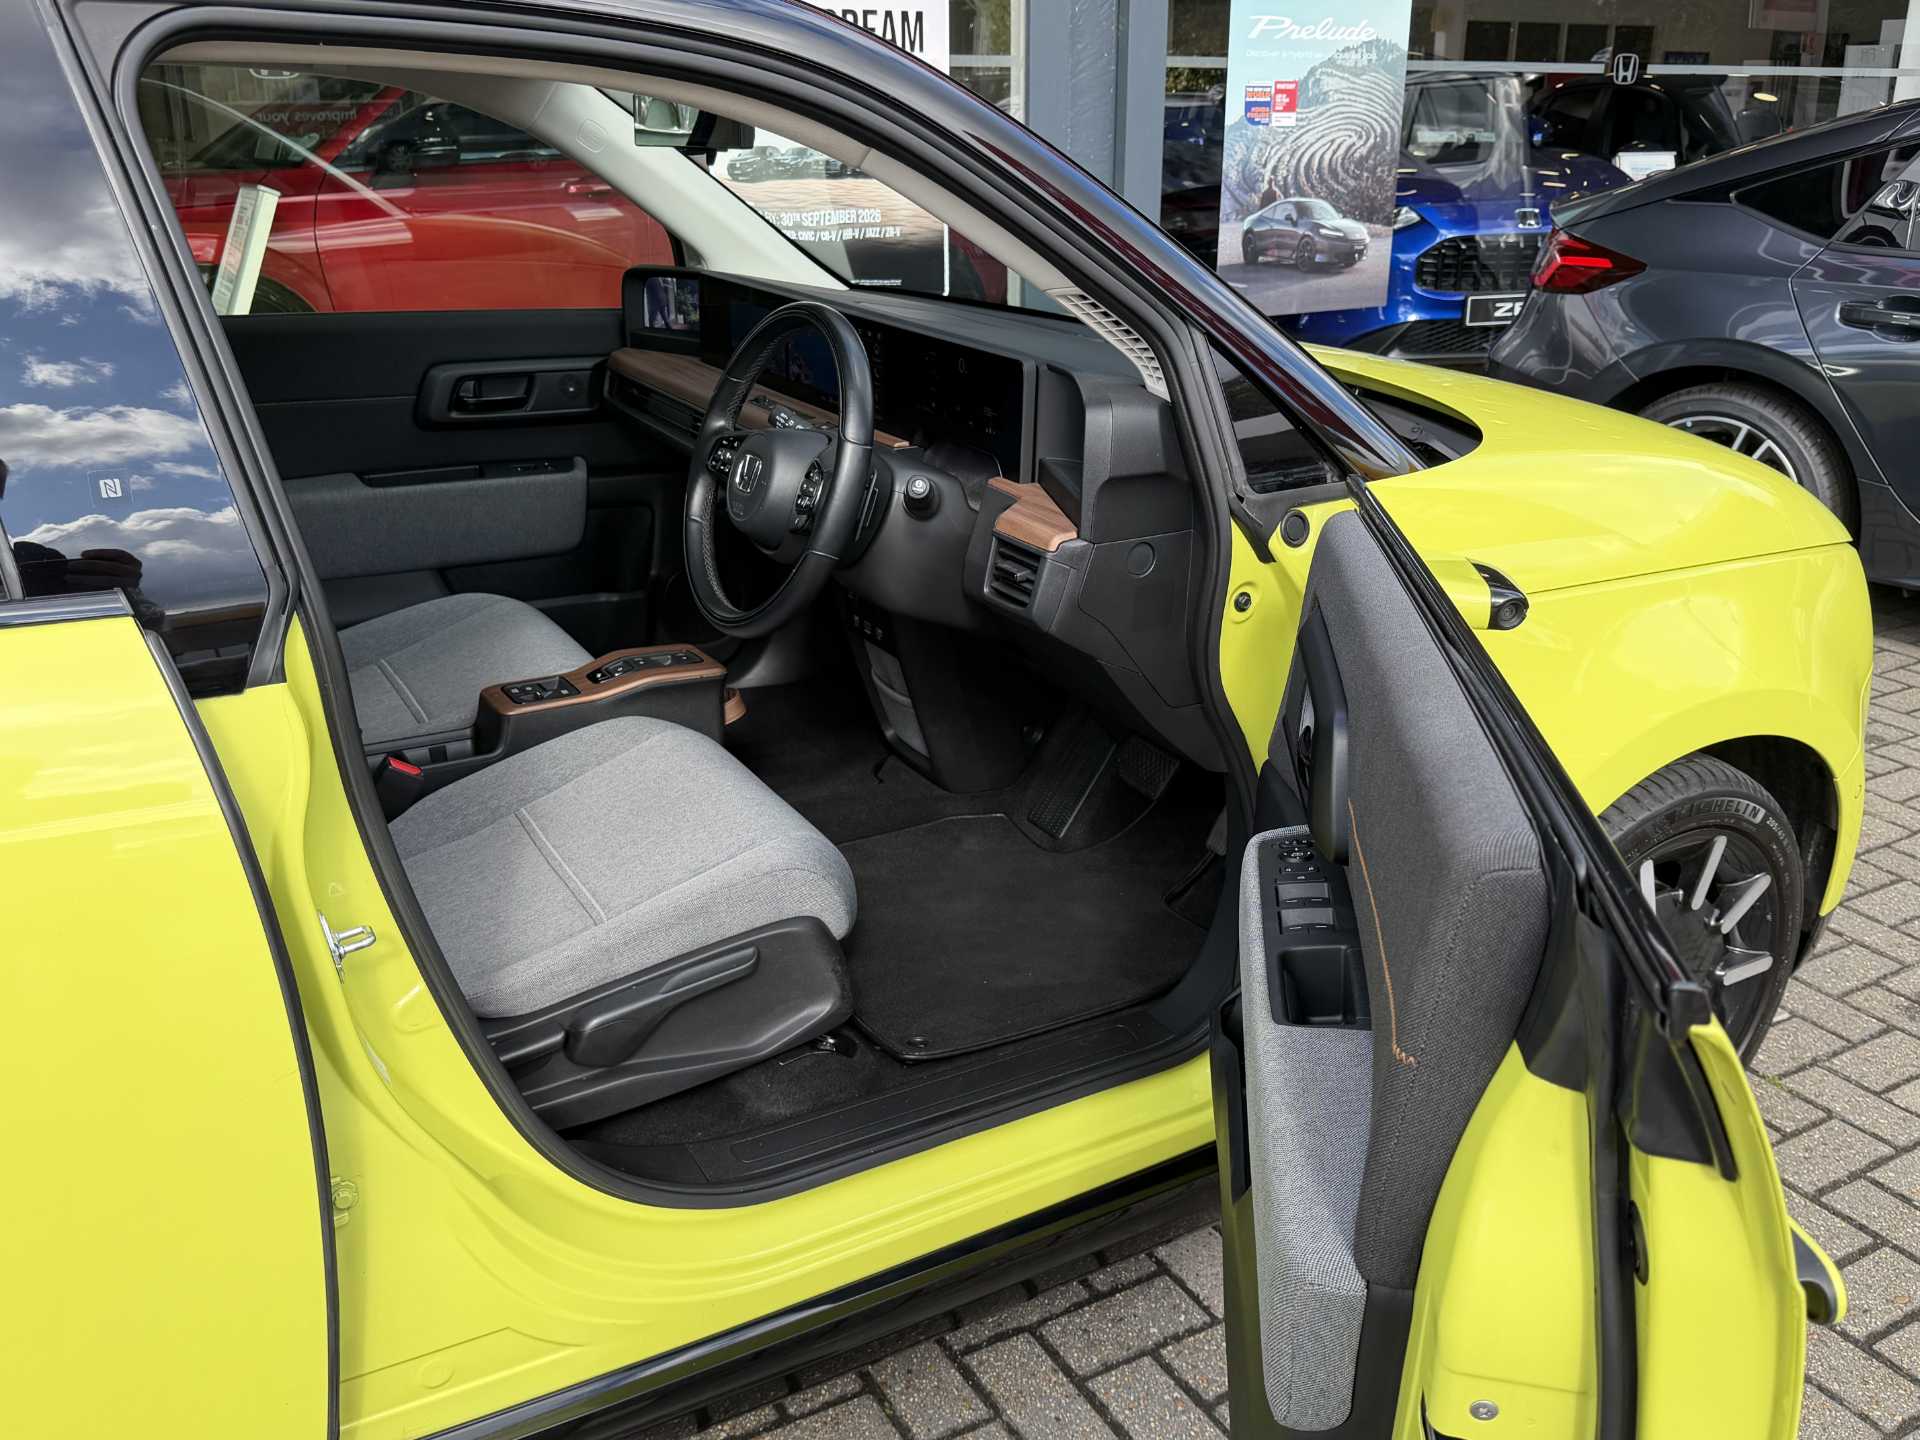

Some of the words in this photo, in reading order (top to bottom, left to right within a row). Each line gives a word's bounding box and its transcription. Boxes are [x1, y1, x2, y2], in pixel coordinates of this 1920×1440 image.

[825, 8, 924, 53] EAM
[1248, 15, 1378, 41] Prelude
[801, 208, 858, 227] SEPTEMBER
